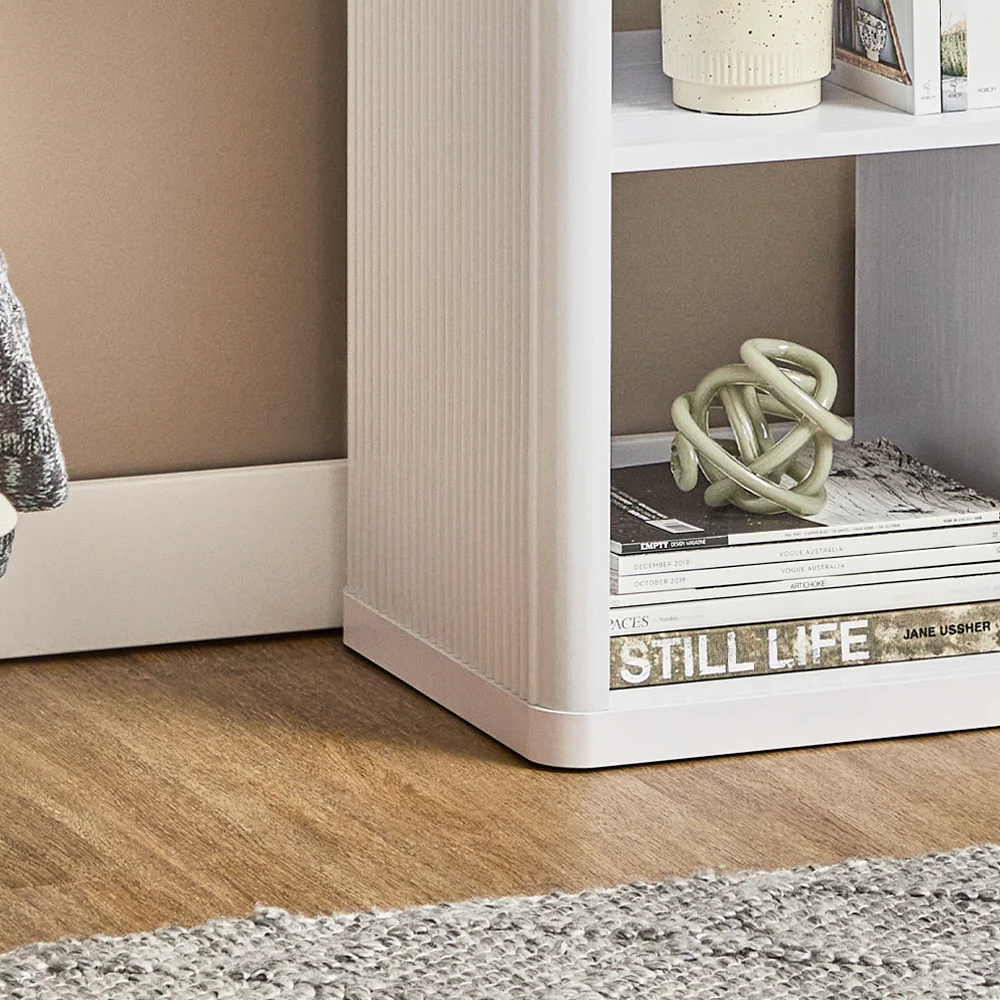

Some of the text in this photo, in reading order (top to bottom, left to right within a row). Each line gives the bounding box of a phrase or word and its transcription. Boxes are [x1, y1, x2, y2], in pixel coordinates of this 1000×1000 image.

[640, 539, 706, 551] EMPTY DESIGN MAGAZINE
[780, 546, 844, 557] VOGUE AUSTRALIA
[634, 559, 690, 571] DECEMBER 2019
[780, 563, 845, 574] VOGUE AUSTRALIA
[634, 577, 686, 588] OCTOBER 2019
[790, 580, 826, 590] ARTICHOKE
[903, 621, 991, 640] JANE USSHER
[620, 619, 870, 684] STILL LIFE
